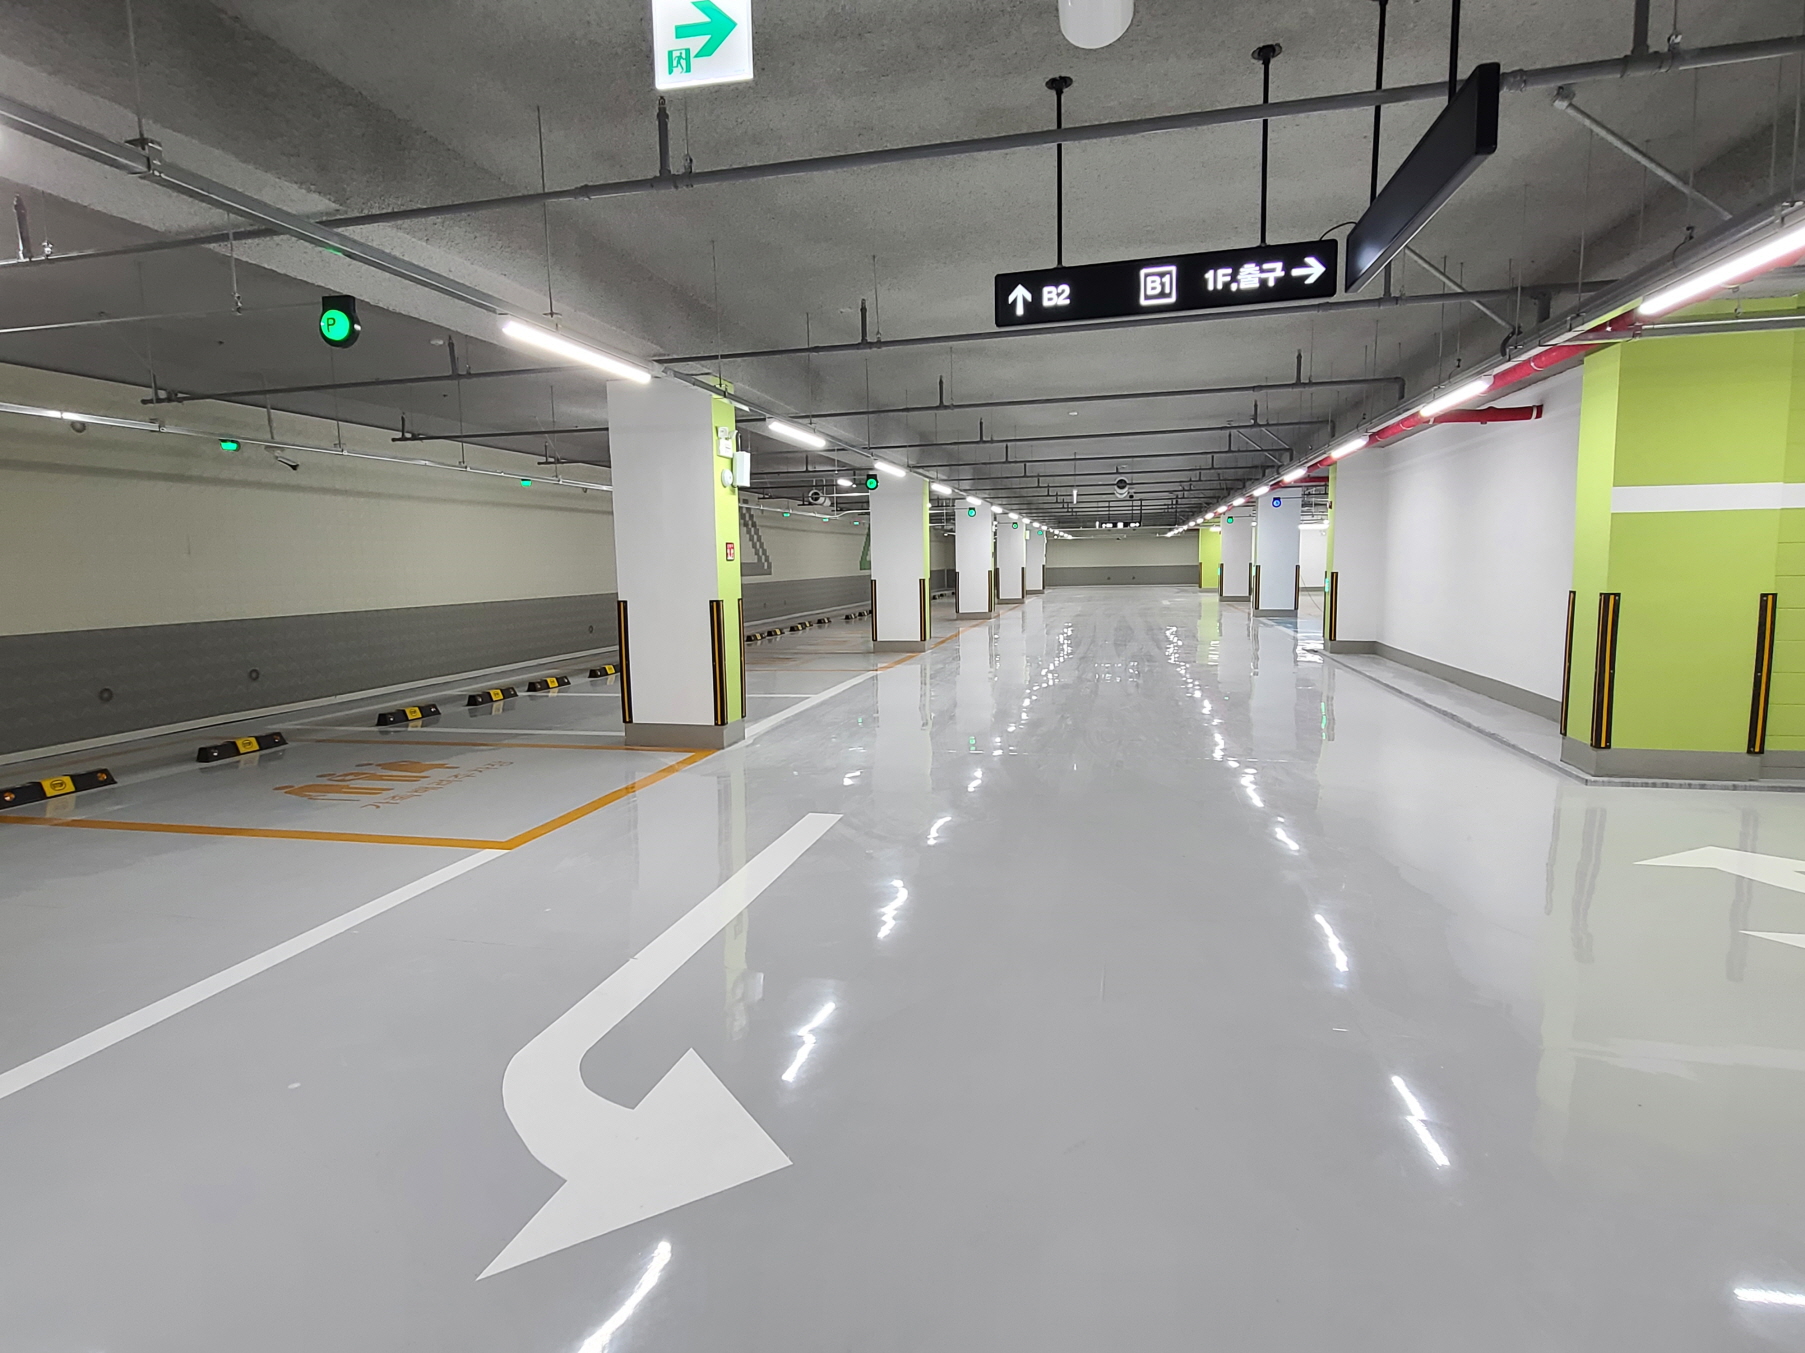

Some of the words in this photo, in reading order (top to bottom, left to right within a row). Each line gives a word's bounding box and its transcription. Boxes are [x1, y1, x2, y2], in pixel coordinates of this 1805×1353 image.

[1145, 273, 1171, 295] B1
[1204, 262, 1284, 291] 1F,출구
[1042, 285, 1070, 307] B2
[326, 317, 336, 333] P
